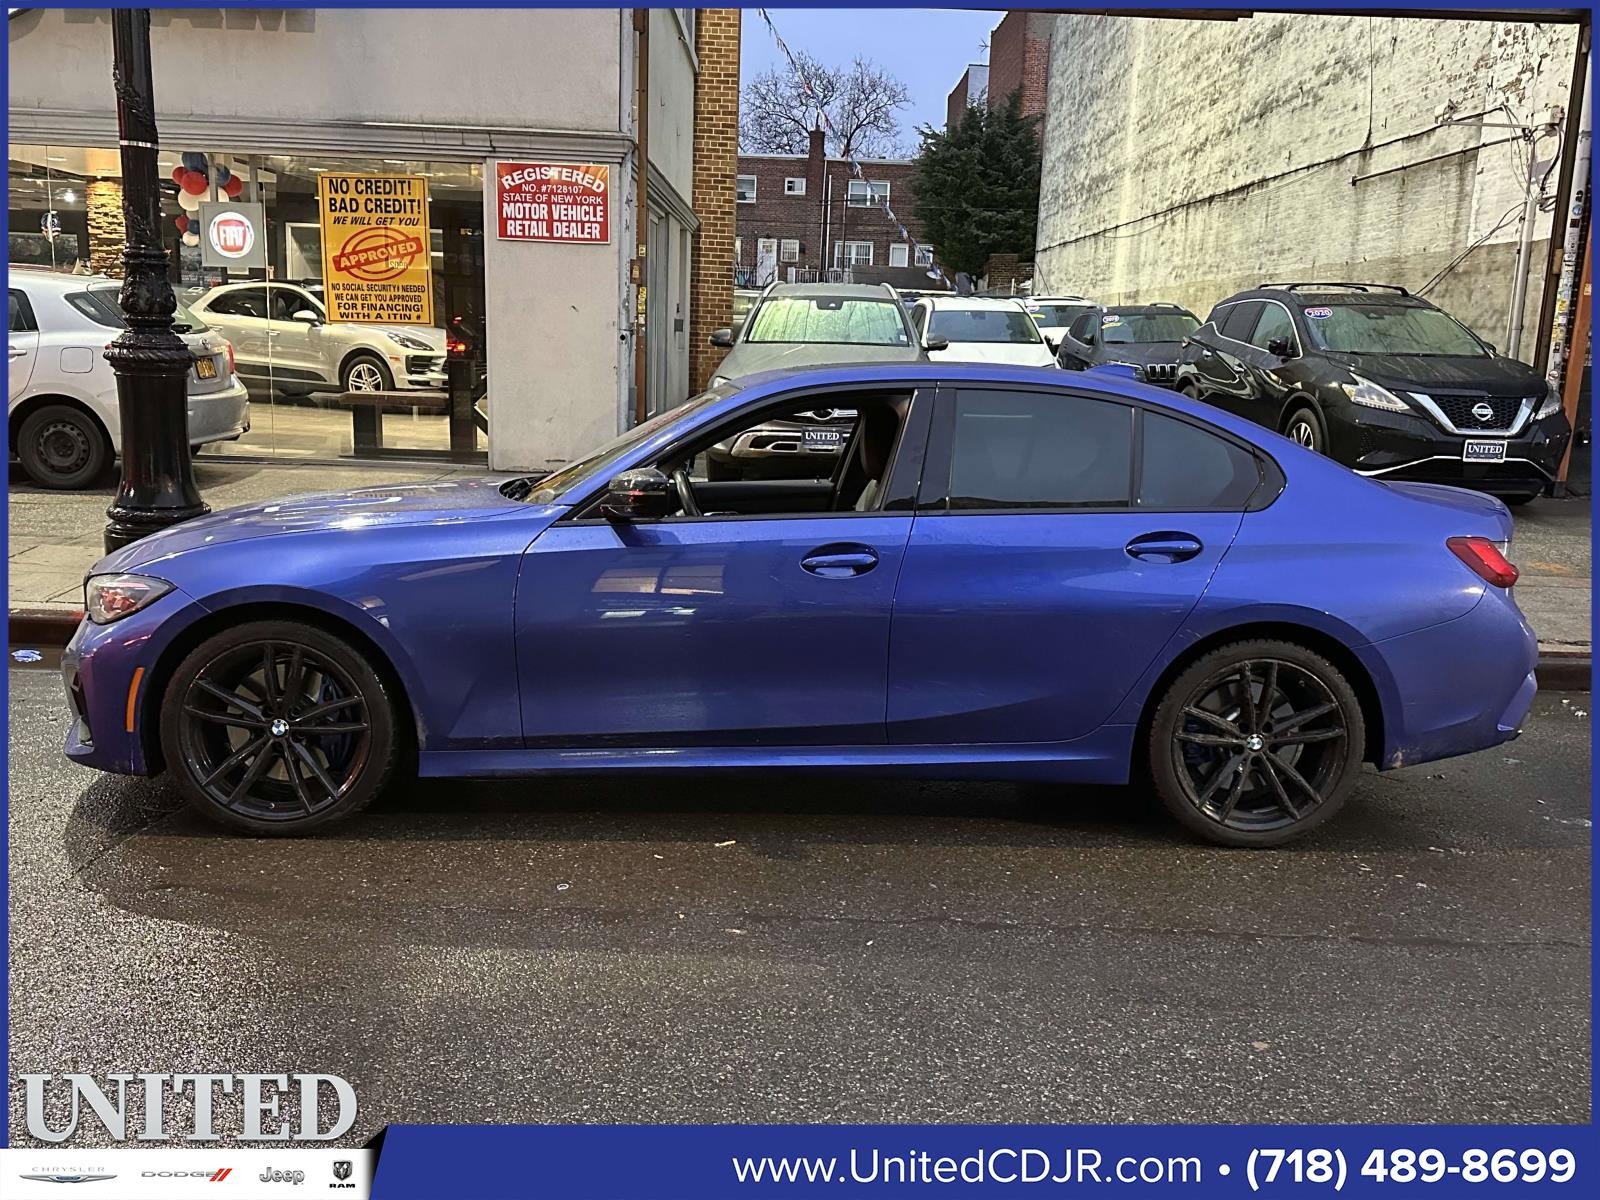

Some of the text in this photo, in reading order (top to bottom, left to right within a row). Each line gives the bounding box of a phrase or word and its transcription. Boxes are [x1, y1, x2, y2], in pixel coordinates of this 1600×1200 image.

[501, 167, 604, 192] REGISTERED
[329, 179, 411, 195] NO CREDIT!
[522, 184, 583, 193] NO. #7128107
[503, 193, 602, 204] STATE OF NEW YORK
[329, 198, 421, 214] BAD CREDIT!
[503, 203, 603, 221] MOTOR VEHICLE
[333, 216, 419, 226] WE WILL GET YOU
[219, 225, 245, 246] FIAT
[507, 220, 600, 238] RETAIL DEALER
[341, 241, 417, 268] APPROVED
[342, 283, 364, 291] SOCIAL
[361, 303, 423, 312] FINANCING!
[805, 431, 839, 440] UNITED
[1468, 445, 1502, 453] UNITED
